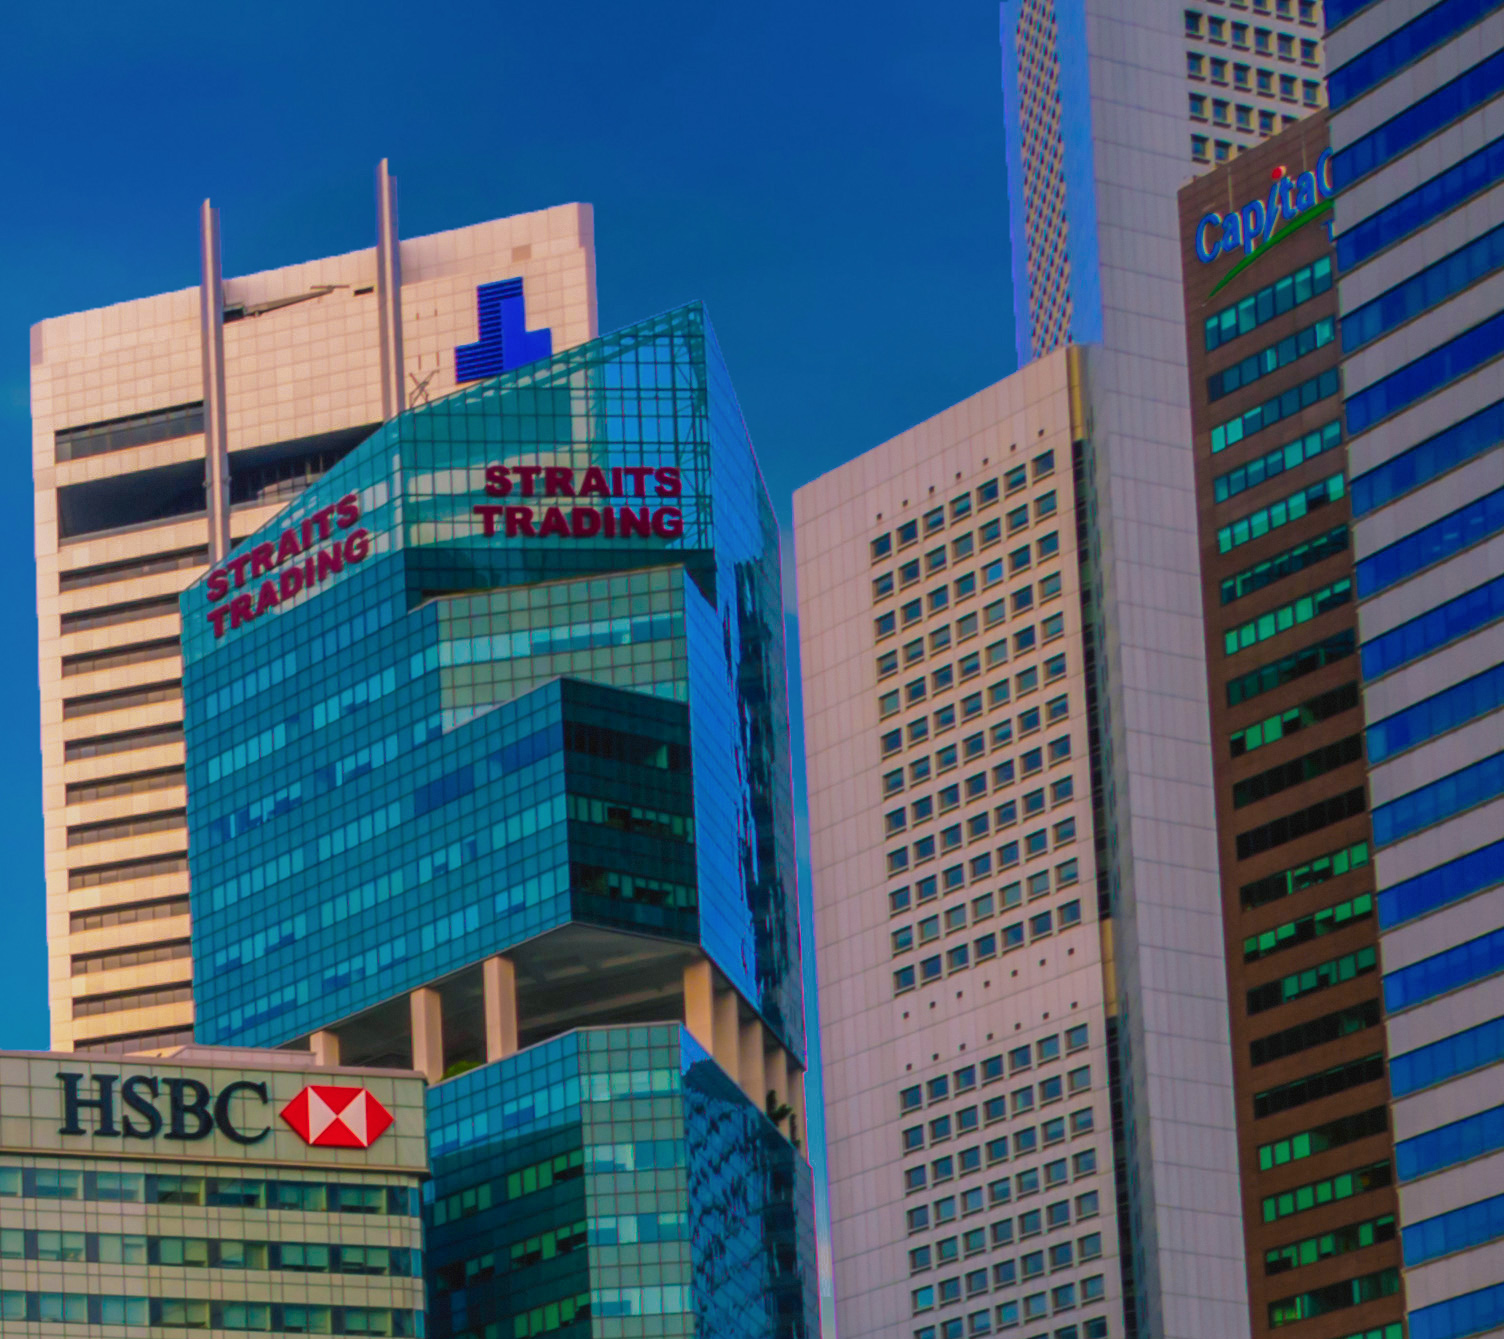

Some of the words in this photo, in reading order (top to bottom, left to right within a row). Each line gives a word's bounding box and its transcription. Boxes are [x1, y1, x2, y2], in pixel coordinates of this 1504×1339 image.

[485, 466, 682, 497] STRAITS
[206, 494, 360, 602] STRAITS
[473, 505, 684, 538] TRADING
[207, 528, 370, 638] TRADING
[56, 1072, 272, 1145] HSBC
